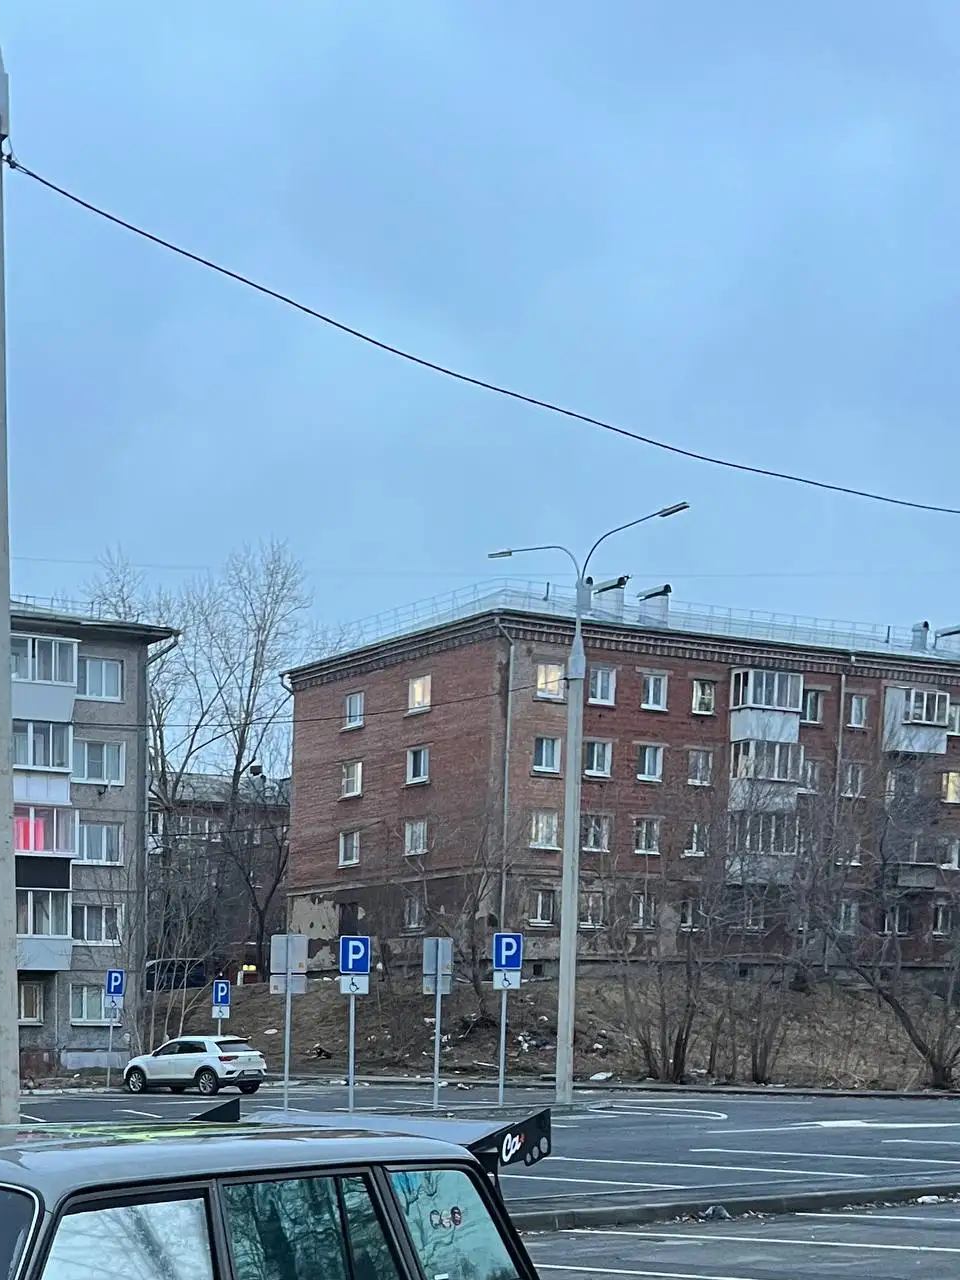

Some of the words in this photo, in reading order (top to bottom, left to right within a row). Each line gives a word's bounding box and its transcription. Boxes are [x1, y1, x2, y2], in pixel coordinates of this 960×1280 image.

[348, 940, 365, 969] P
[501, 937, 517, 966] P
[111, 972, 122, 993] P
[217, 983, 228, 1003] P
